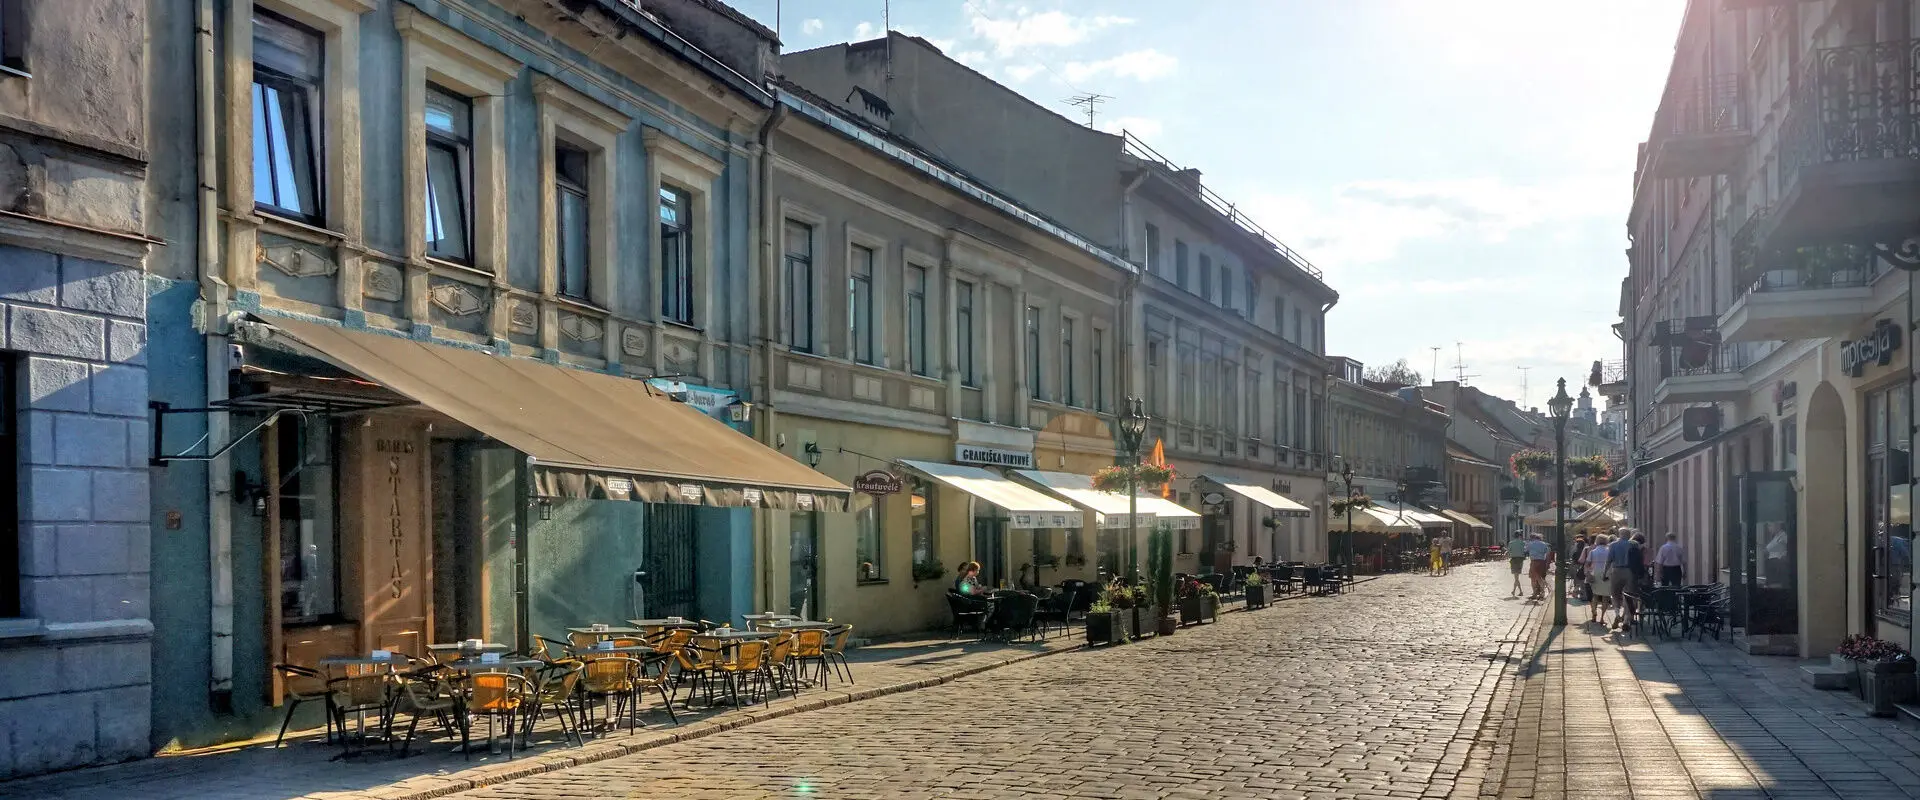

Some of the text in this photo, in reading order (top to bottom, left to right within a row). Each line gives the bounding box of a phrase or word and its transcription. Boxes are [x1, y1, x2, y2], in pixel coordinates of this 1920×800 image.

[962, 449, 1030, 466] GRAIKIŠKA VIRTUVĖ
[388, 455, 402, 599] STARTAS
